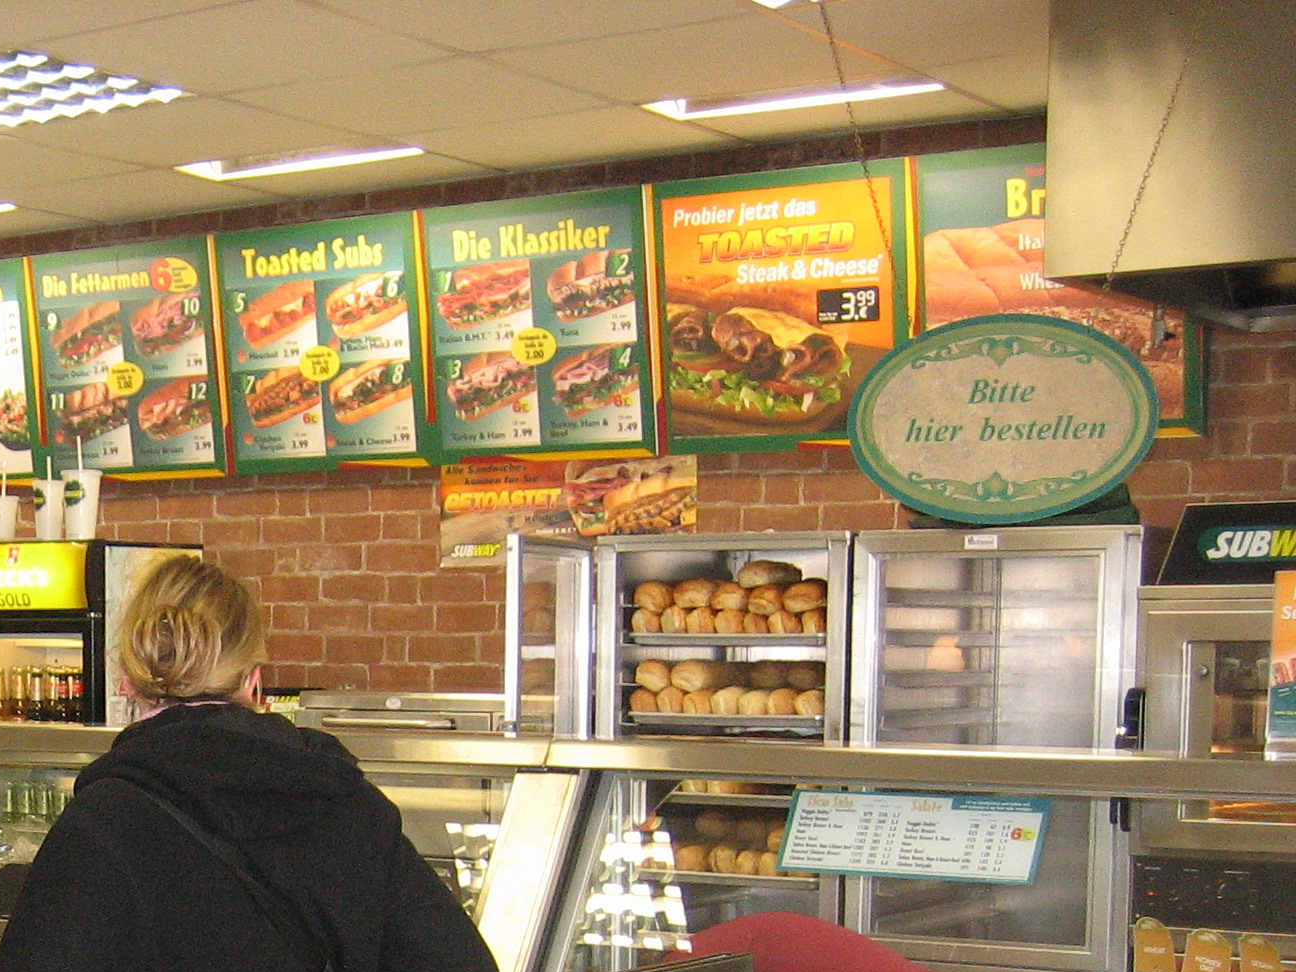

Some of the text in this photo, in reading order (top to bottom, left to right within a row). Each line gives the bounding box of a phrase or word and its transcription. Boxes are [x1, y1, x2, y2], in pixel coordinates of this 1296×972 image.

[1006, 177, 1046, 218] Br
[673, 198, 816, 228] Probier jetzt das
[452, 218, 611, 263] Die Klassiker
[697, 221, 856, 264] TOASTED
[1018, 232, 1045, 251] Ita
[241, 234, 384, 279] Toasted Subs
[616, 254, 630, 276] 2
[42, 274, 67, 299] Die
[70, 270, 150, 295] Fettarmen
[150, 257, 172, 292] 6
[736, 259, 789, 284] Steak
[791, 260, 806, 279] &
[1019, 271, 1065, 291] Whe
[386, 276, 400, 298] 6
[183, 298, 200, 317] 10
[234, 293, 247, 313] 5
[47, 312, 57, 330] 9
[619, 347, 631, 367] 4
[392, 364, 404, 384] 8
[451, 359, 462, 379] 3
[50, 393, 65, 409] 11
[191, 382, 207, 400] 12
[968, 378, 1035, 405] Bitte
[904, 414, 1108, 443] hier bestellen
[444, 488, 563, 512] GETOASTET
[451, 542, 503, 558] SUBWAY
[1206, 529, 1296, 560] SUBW
